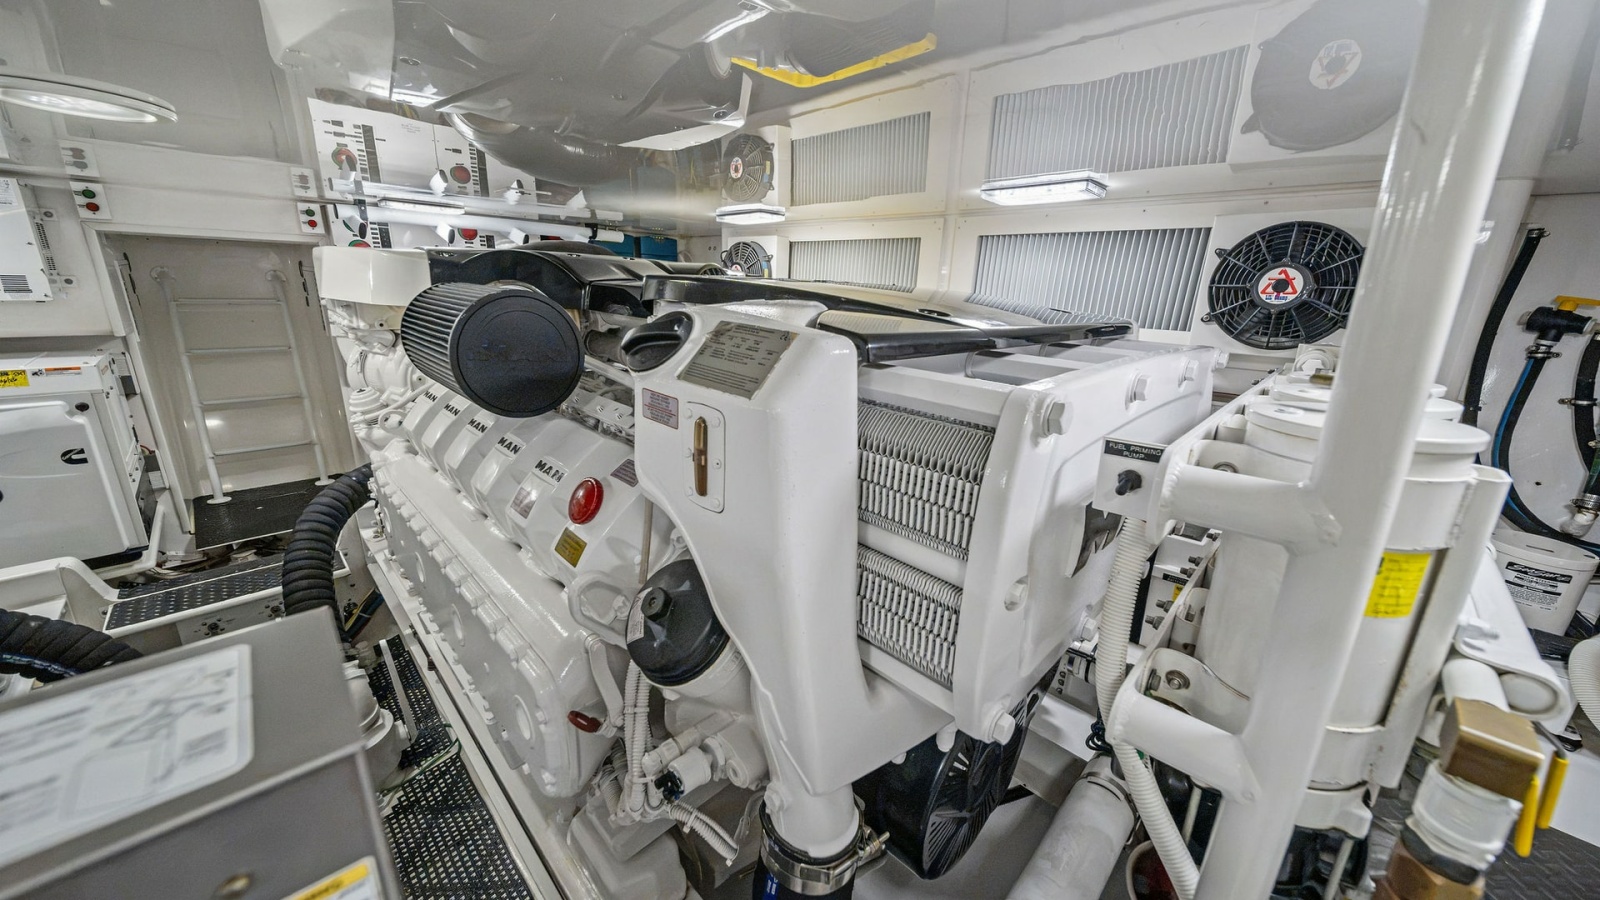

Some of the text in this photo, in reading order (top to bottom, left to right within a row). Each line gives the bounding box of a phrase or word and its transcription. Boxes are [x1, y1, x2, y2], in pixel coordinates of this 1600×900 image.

[423, 390, 438, 402] MAN
[444, 403, 461, 417] MAN
[468, 418, 488, 433] MAN
[497, 436, 522, 455] MAN
[1109, 442, 1161, 456] FUEL PRIMING
